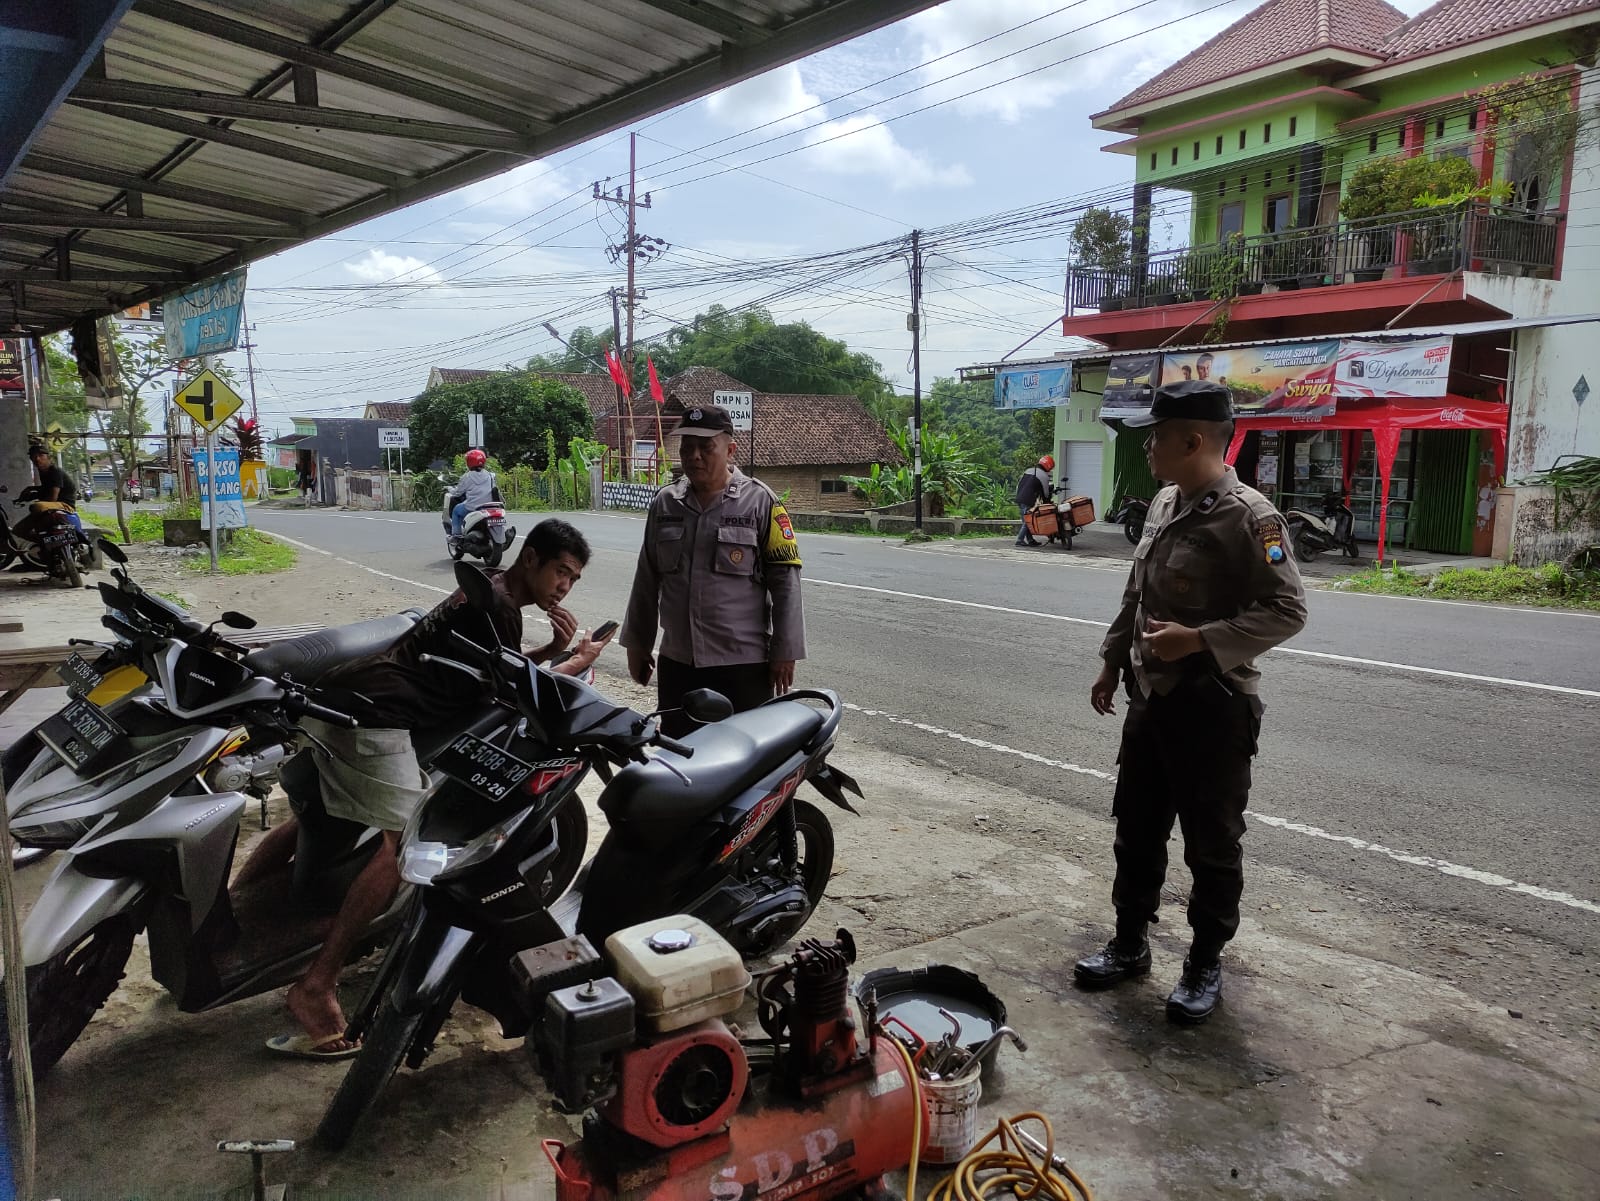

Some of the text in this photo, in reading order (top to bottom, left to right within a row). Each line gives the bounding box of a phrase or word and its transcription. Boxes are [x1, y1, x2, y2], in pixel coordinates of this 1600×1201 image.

[1293, 347, 1318, 358] SURYA
[1366, 360, 1438, 383] Diplomat
[716, 395, 750, 405] SMPN 3
[1285, 379, 1331, 404] Surya
[730, 410, 751, 420] OSAN
[200, 482, 240, 496] MLANG
[189, 671, 216, 687] HONDA
[64, 703, 84, 722] AE
[73, 713, 101, 738] 5260
[451, 737, 477, 754] AE
[470, 745, 506, 770] 5088
[481, 881, 525, 904] HONDA
